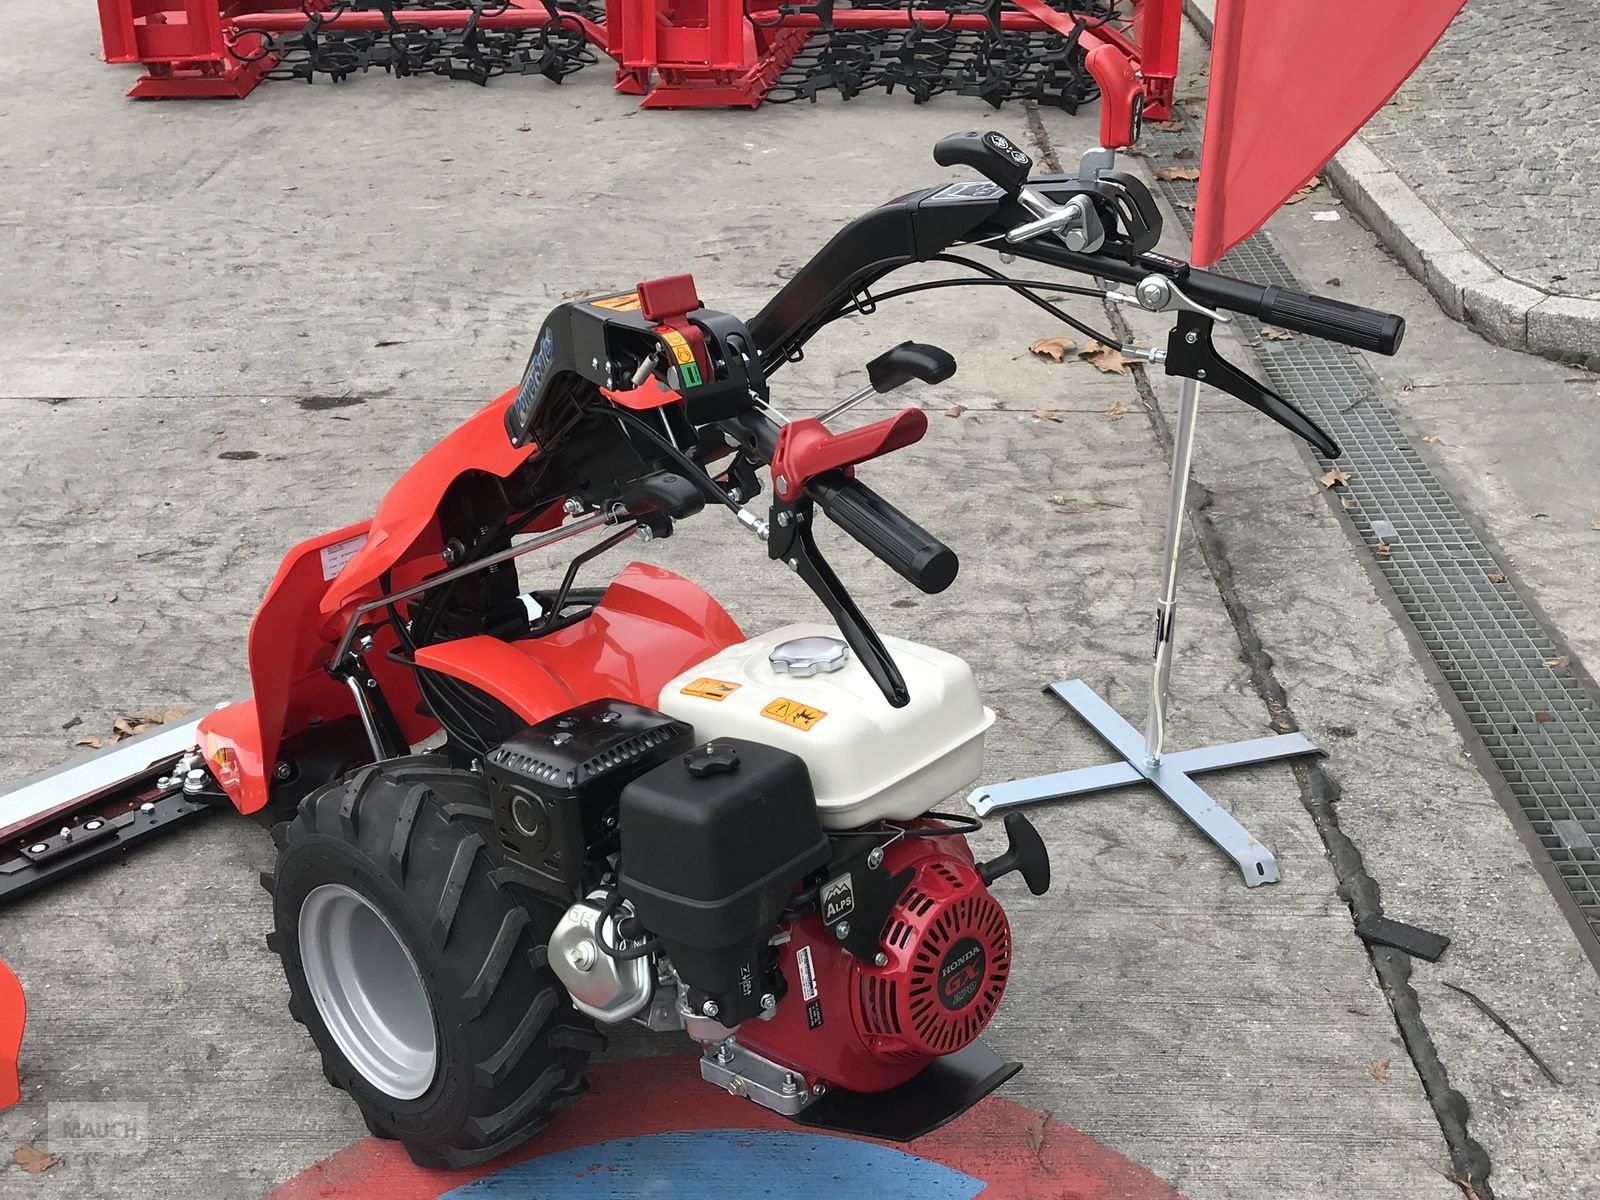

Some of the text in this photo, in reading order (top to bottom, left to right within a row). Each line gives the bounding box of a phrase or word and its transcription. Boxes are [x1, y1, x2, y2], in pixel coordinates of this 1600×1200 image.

[515, 335, 554, 414] PowerSafe
[827, 896, 852, 918] ALPS
[942, 946, 981, 977] HONDA
[945, 958, 981, 997] GX
